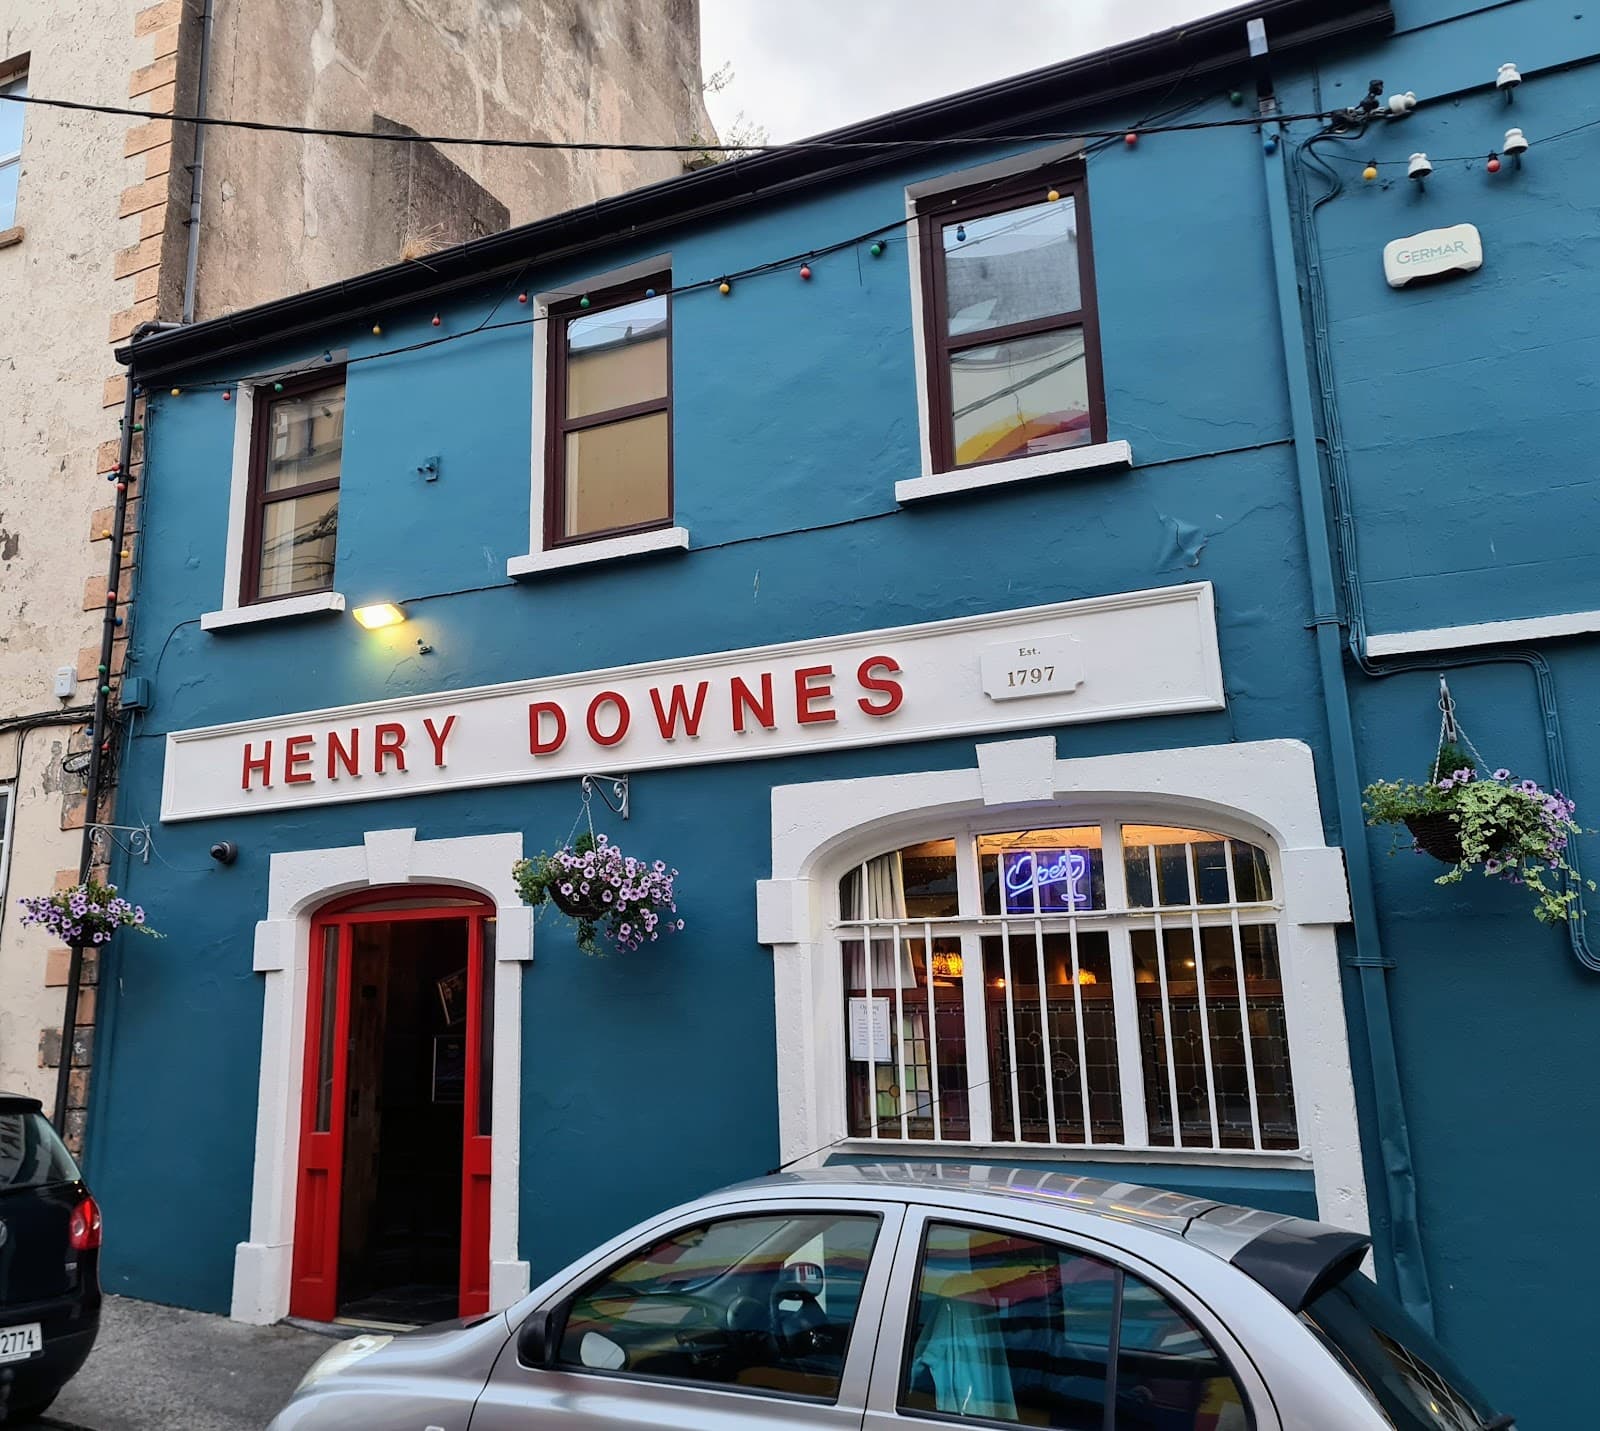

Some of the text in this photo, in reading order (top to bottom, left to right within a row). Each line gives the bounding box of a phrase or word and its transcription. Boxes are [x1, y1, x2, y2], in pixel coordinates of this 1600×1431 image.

[1397, 241, 1469, 264] GERMAR
[1019, 648, 1041, 657] Est.
[1008, 666, 1055, 687] 1797
[242, 655, 903, 789] HENRY DOWNES
[1006, 855, 1081, 890] Open
[1, 1330, 34, 1354] 2774
